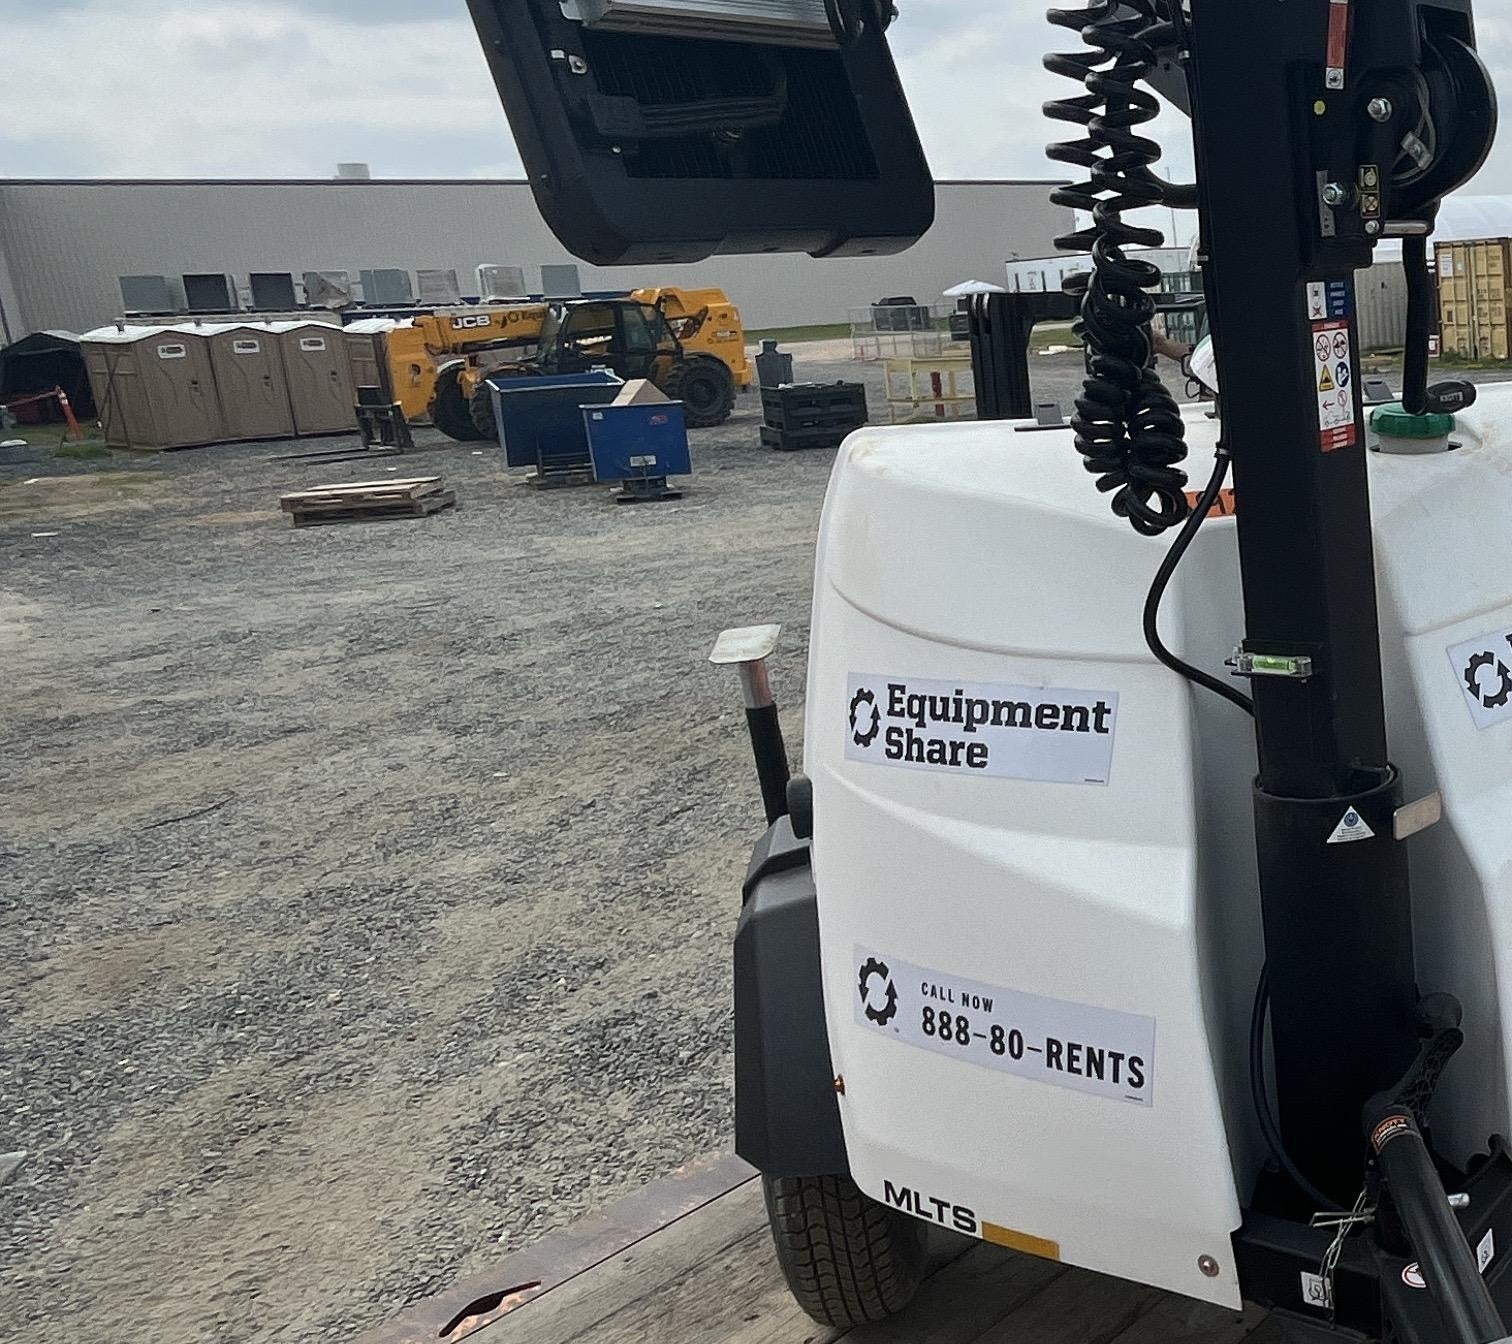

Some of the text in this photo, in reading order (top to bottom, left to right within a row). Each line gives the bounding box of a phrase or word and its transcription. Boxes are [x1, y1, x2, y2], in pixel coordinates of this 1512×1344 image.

[452, 315, 491, 329] JCB
[886, 683, 1112, 734] Equipment
[885, 729, 989, 769] Share
[921, 982, 994, 1014] CALL NOW
[921, 1005, 1145, 1089] 888-80-RENTS
[884, 1179, 977, 1234] MLTS
